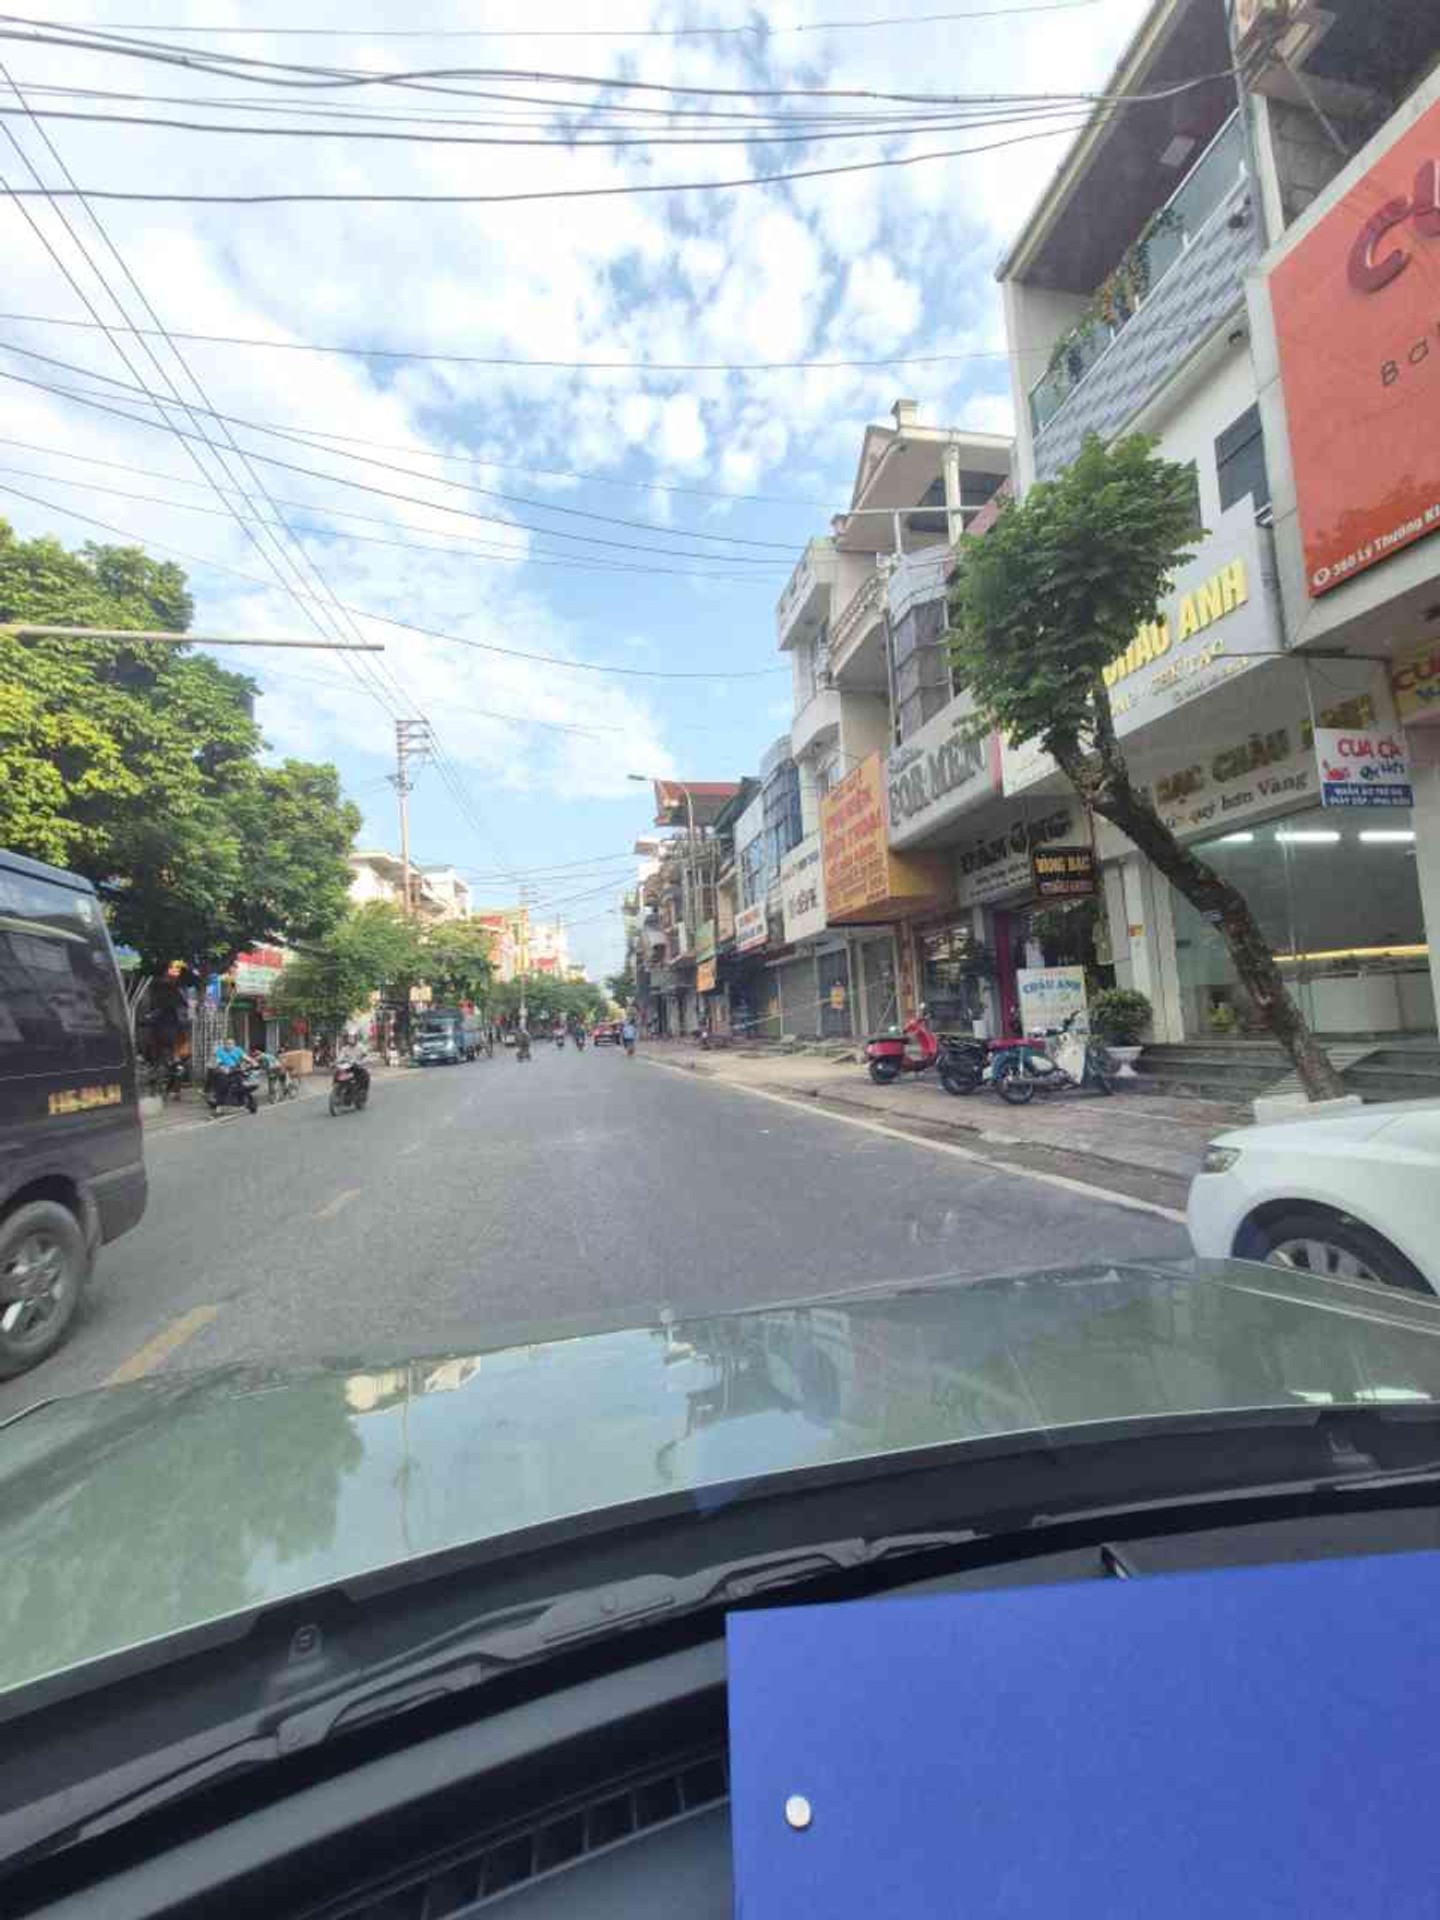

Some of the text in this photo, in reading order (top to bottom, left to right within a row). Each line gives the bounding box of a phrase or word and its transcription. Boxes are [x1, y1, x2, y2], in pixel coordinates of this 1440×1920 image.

[1177, 556, 1249, 642] ANH
[888, 764, 932, 827] FOR
[929, 738, 985, 799] MEN
